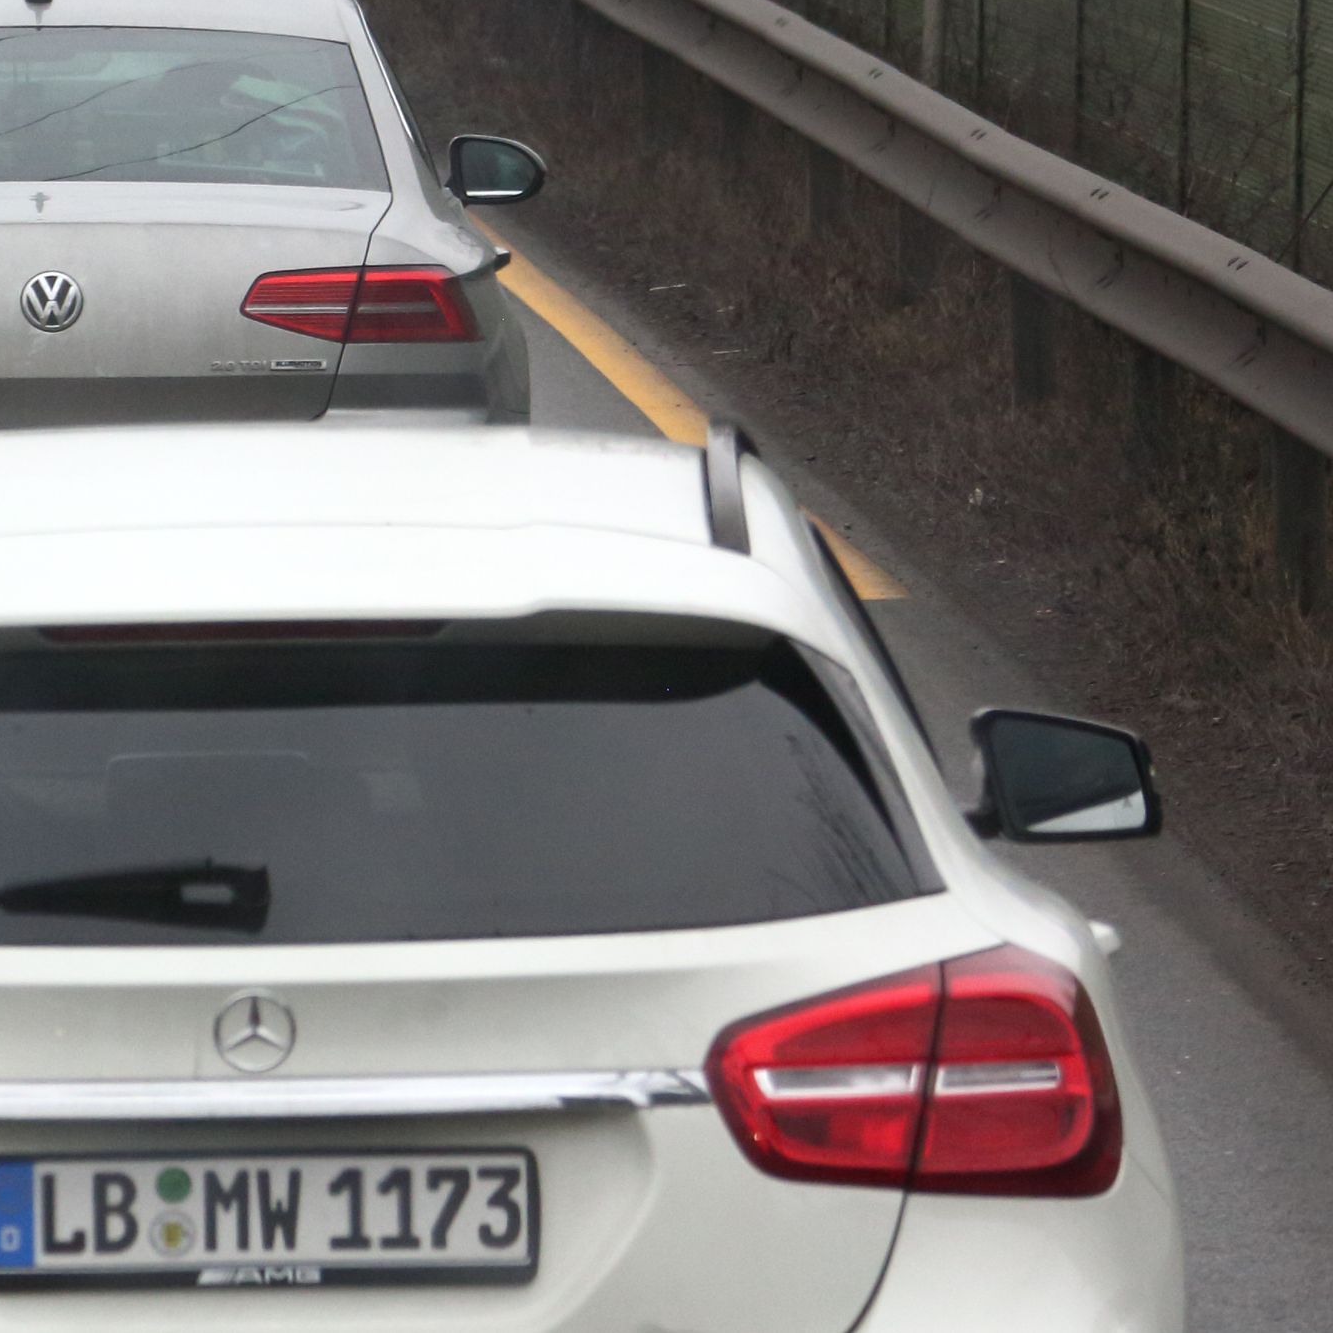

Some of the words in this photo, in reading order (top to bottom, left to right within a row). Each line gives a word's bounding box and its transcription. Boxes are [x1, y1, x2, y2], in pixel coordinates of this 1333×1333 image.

[41, 1171, 138, 1254] LB
[203, 1169, 301, 1252] MW
[328, 1167, 522, 1250] 1173
[0, 1225, 21, 1252] D
[232, 1267, 322, 1284] AMG
